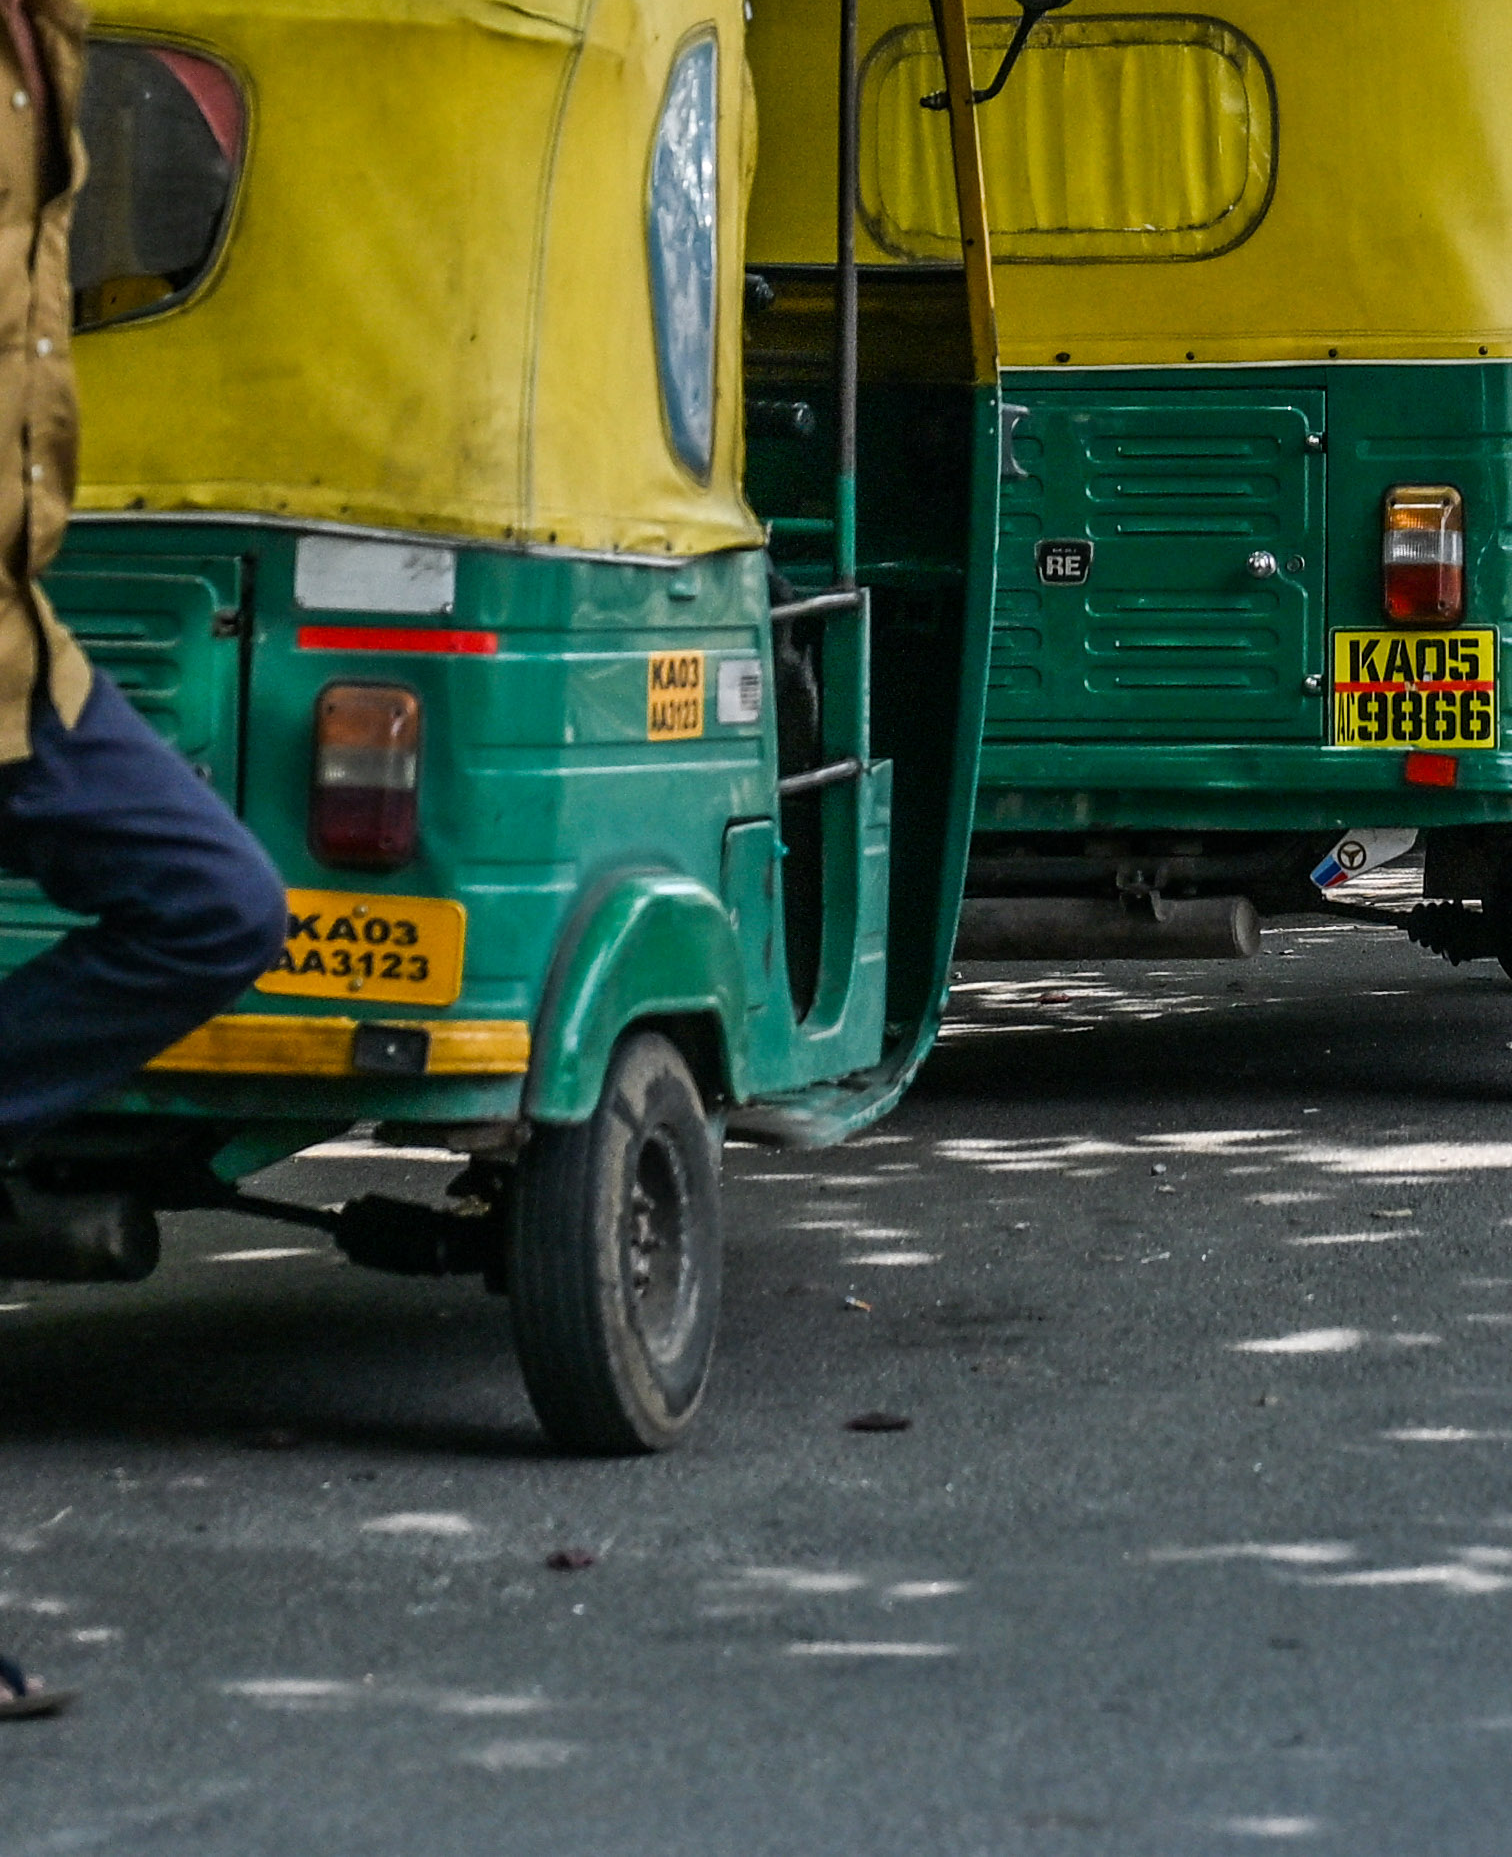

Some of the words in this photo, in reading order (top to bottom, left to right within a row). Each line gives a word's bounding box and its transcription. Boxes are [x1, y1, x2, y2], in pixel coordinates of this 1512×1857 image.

[1046, 555, 1081, 576] RE
[652, 656, 699, 690] KA03
[1349, 638, 1480, 683] KA05
[287, 912, 419, 946] KA03
[272, 948, 430, 983] AA3123
